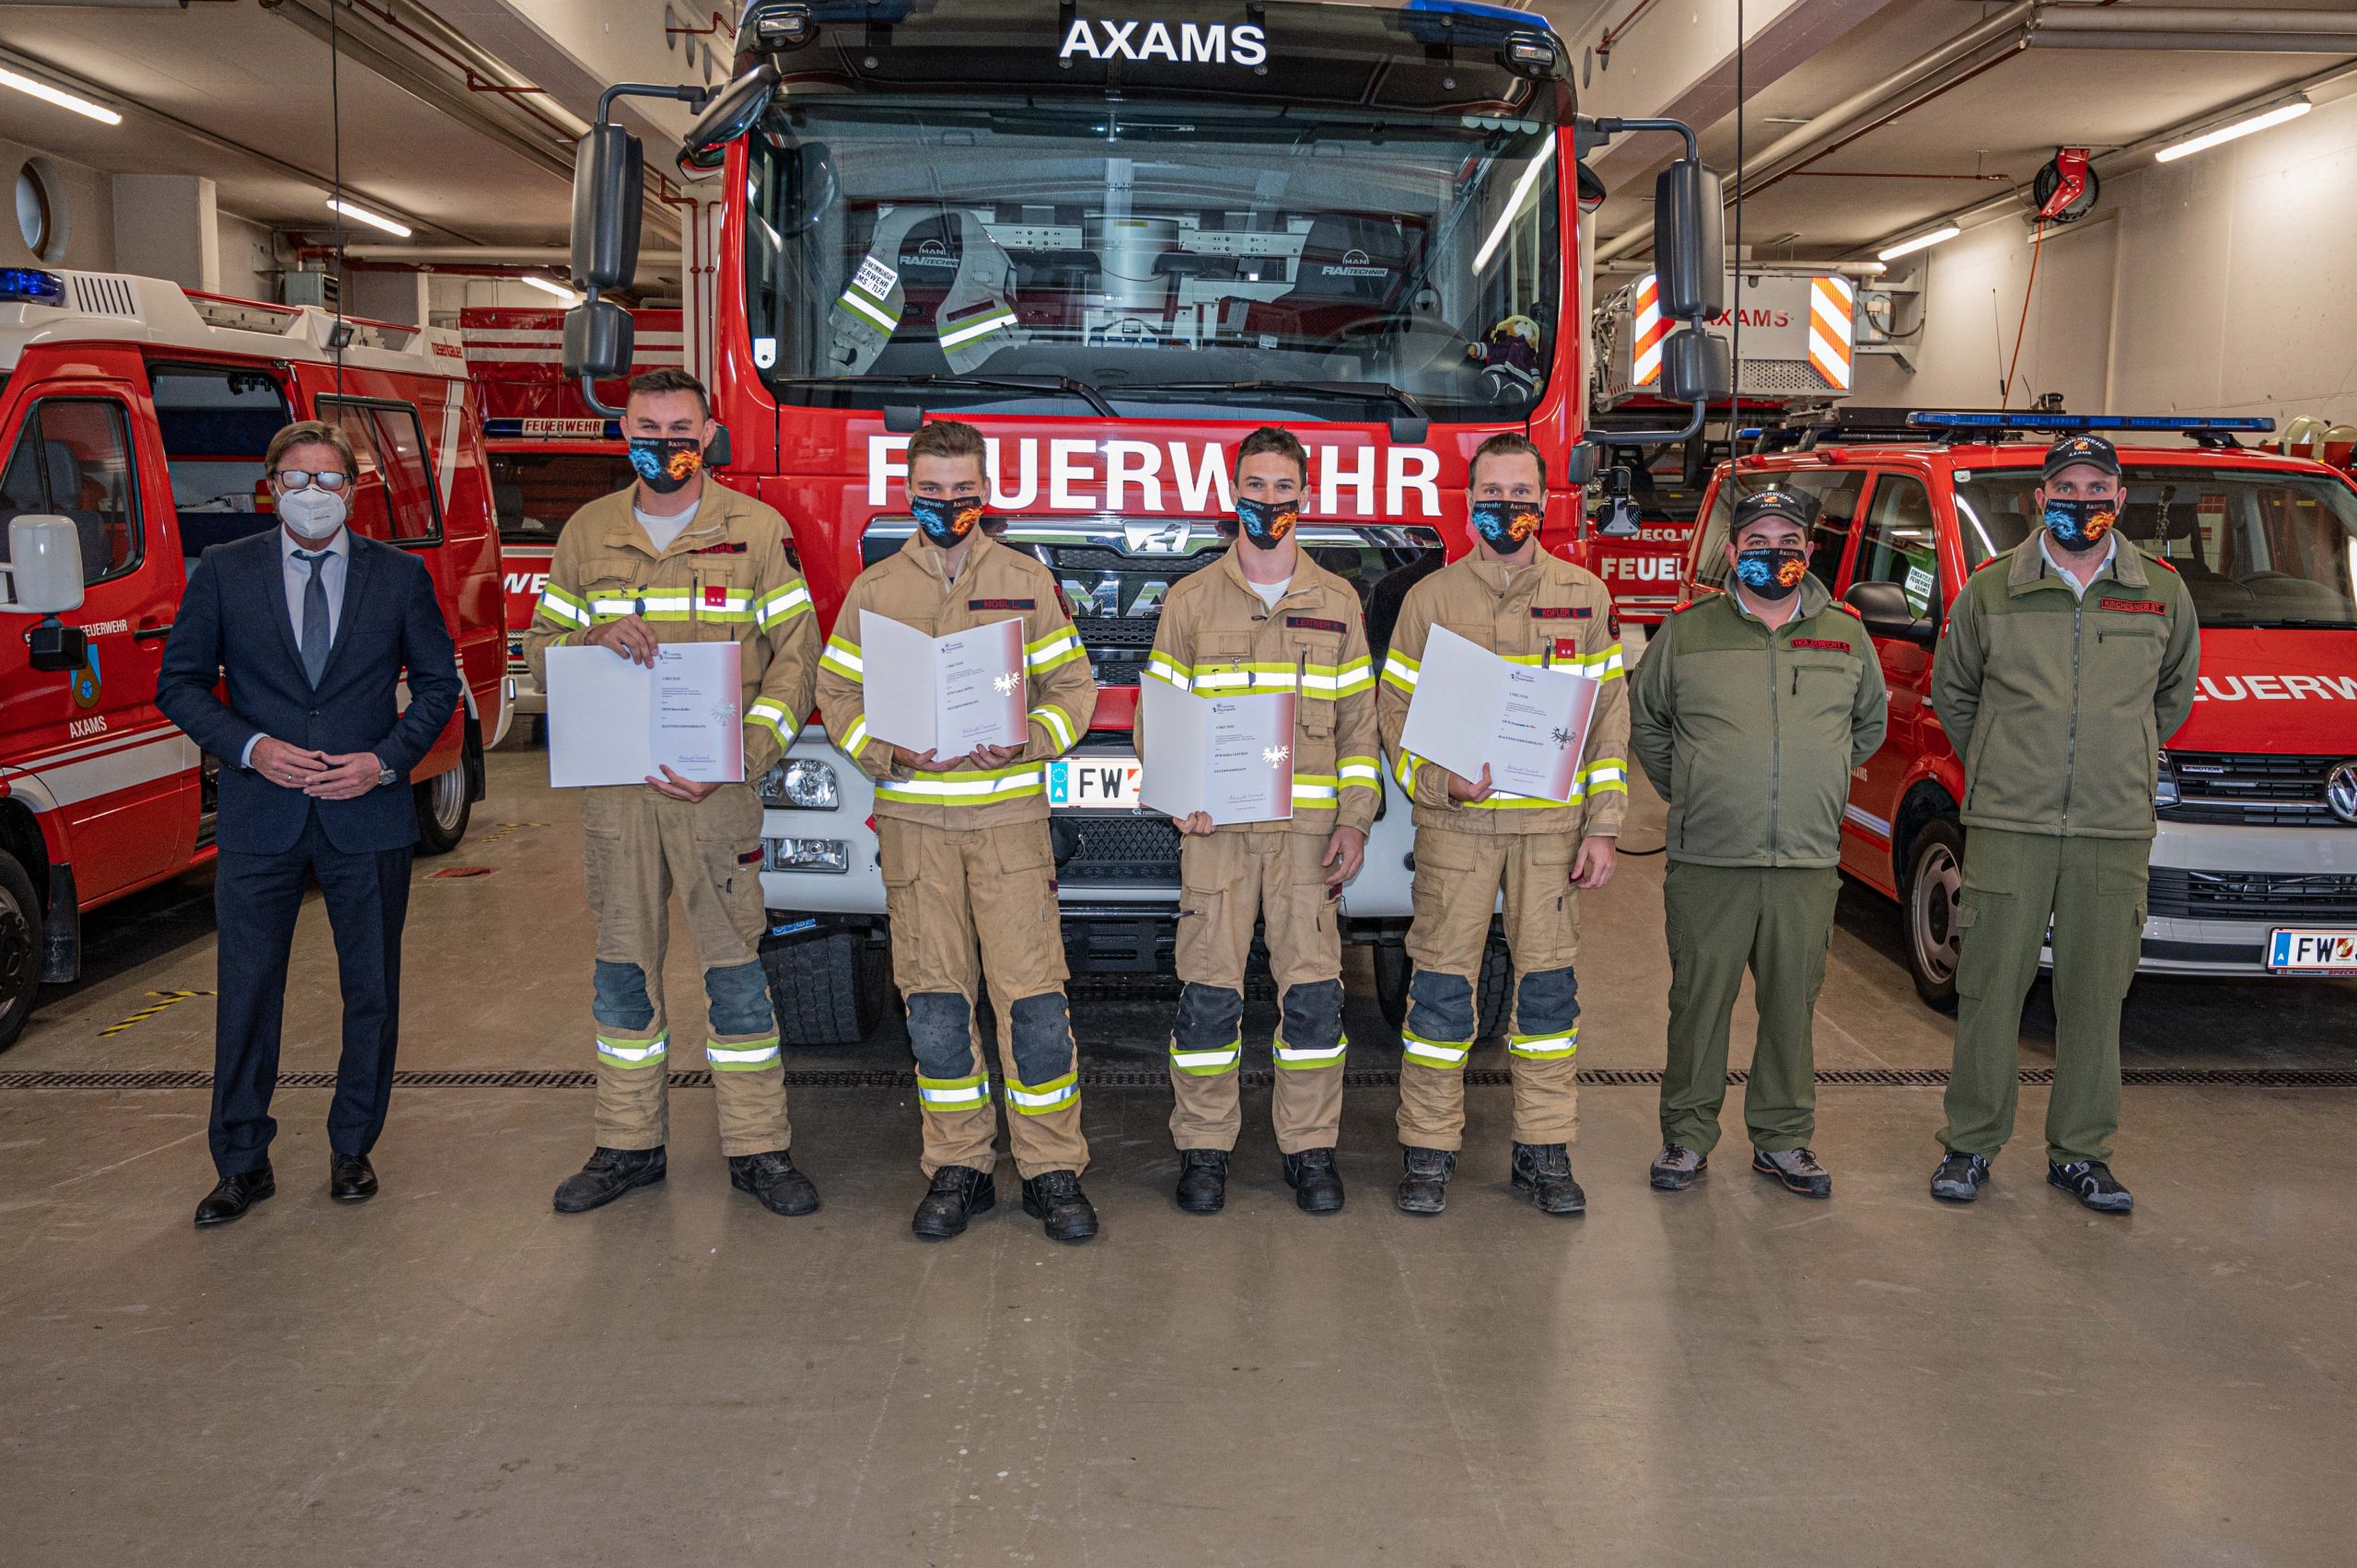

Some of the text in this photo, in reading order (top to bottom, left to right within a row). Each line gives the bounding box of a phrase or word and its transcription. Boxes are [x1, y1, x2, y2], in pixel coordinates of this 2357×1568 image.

[1059, 19, 1267, 66] AXAMS
[1710, 308, 1789, 328] XAMS
[525, 420, 600, 432] FEUERWEHR
[867, 435, 1444, 517] FUERWHR
[953, 500, 974, 508] Axams
[1239, 498, 1265, 511] euerwehr
[2048, 499, 2078, 509] Feuerwehr
[1542, 608, 1570, 617] KOFLER
[1295, 618, 1330, 629] LEITNER
[69, 715, 108, 738] AXAMS
[1054, 786, 1064, 797] A
[2277, 937, 2336, 963] A FW
